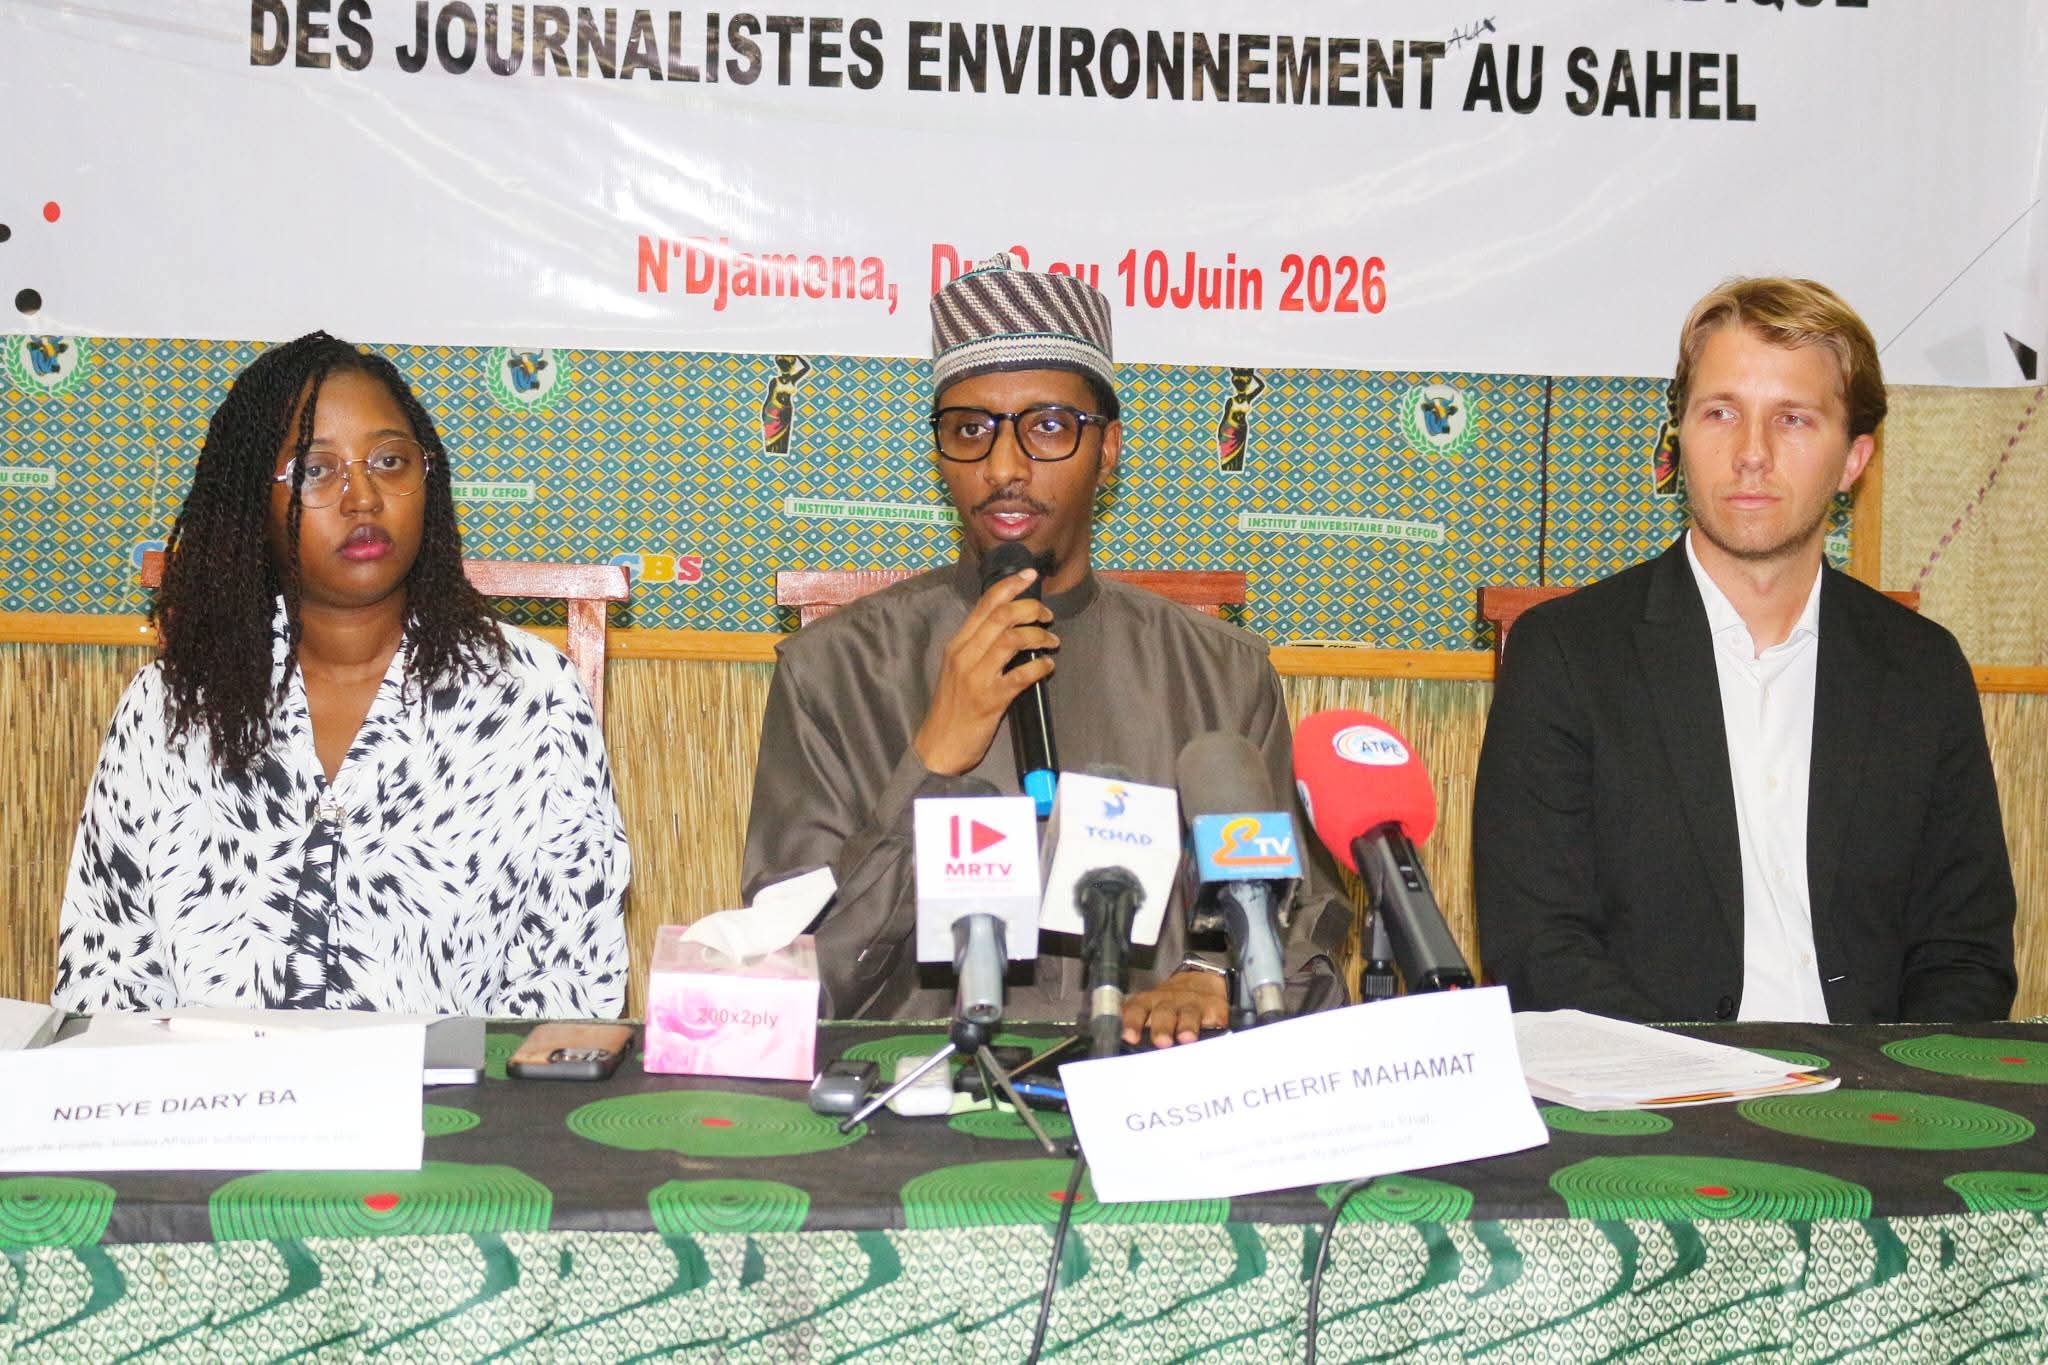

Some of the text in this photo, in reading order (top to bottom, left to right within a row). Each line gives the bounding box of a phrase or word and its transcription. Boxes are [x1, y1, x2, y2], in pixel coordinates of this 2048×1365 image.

[249, 0, 1757, 121] DES JOURNALISTES ENVIRONNEMENT AU SAHEL
[1118, 248, 1263, 310] 10Juin
[1279, 253, 1387, 314] 2026
[12, 472, 49, 483] CEFOD
[472, 487, 488, 497] DU
[492, 487, 527, 498] CEFOD
[793, 502, 844, 515] INSTITUT
[847, 505, 934, 521] UNIVERSITAIRE
[938, 511, 953, 521] DU
[1247, 517, 1439, 540] INSTITUT UNIVERSITAIRE DU CEFOD
[1085, 826, 1153, 846] TCHAD
[944, 863, 1012, 876] MRTV
[1125, 1053, 1476, 1132] GASSIM CHERIF MAHAMAT
[53, 1089, 297, 1121] NDEYE DIARY BA
